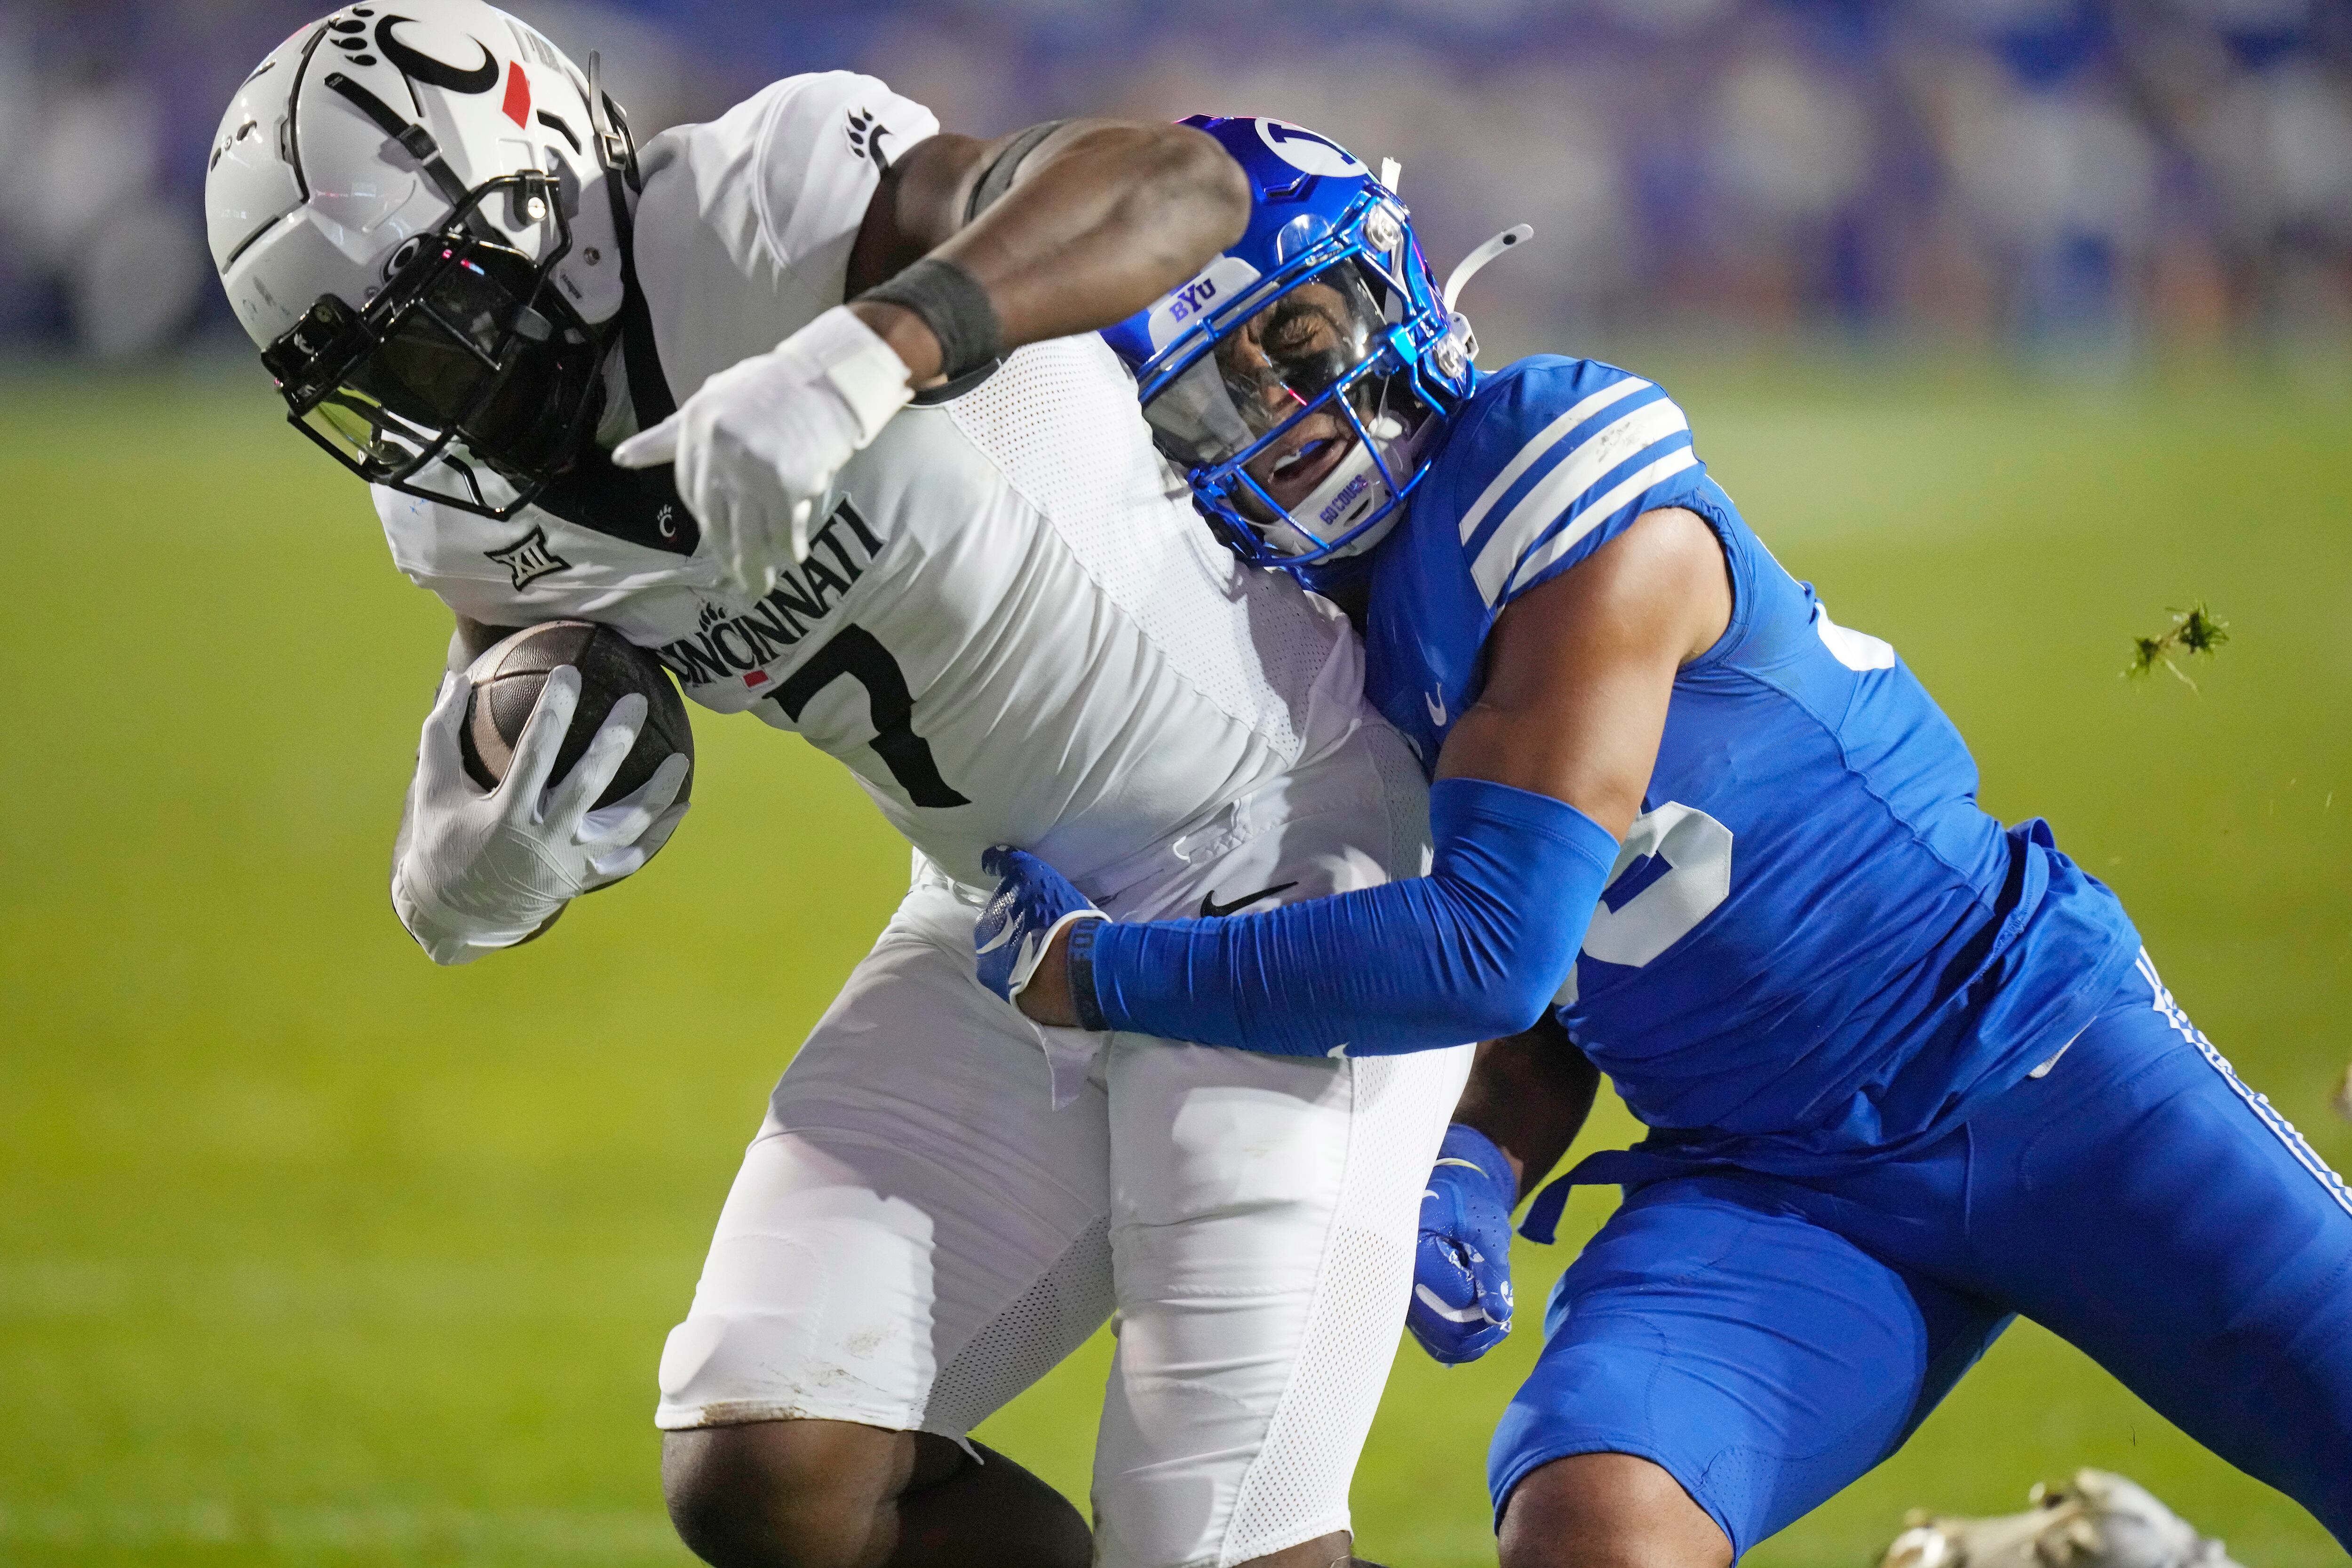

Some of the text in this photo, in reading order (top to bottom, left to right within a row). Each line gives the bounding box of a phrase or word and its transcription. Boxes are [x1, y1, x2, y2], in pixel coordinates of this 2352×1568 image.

[1169, 278, 1216, 323] BYU
[1320, 474, 1368, 525] GO COUGS
[762, 625, 972, 808] 7
